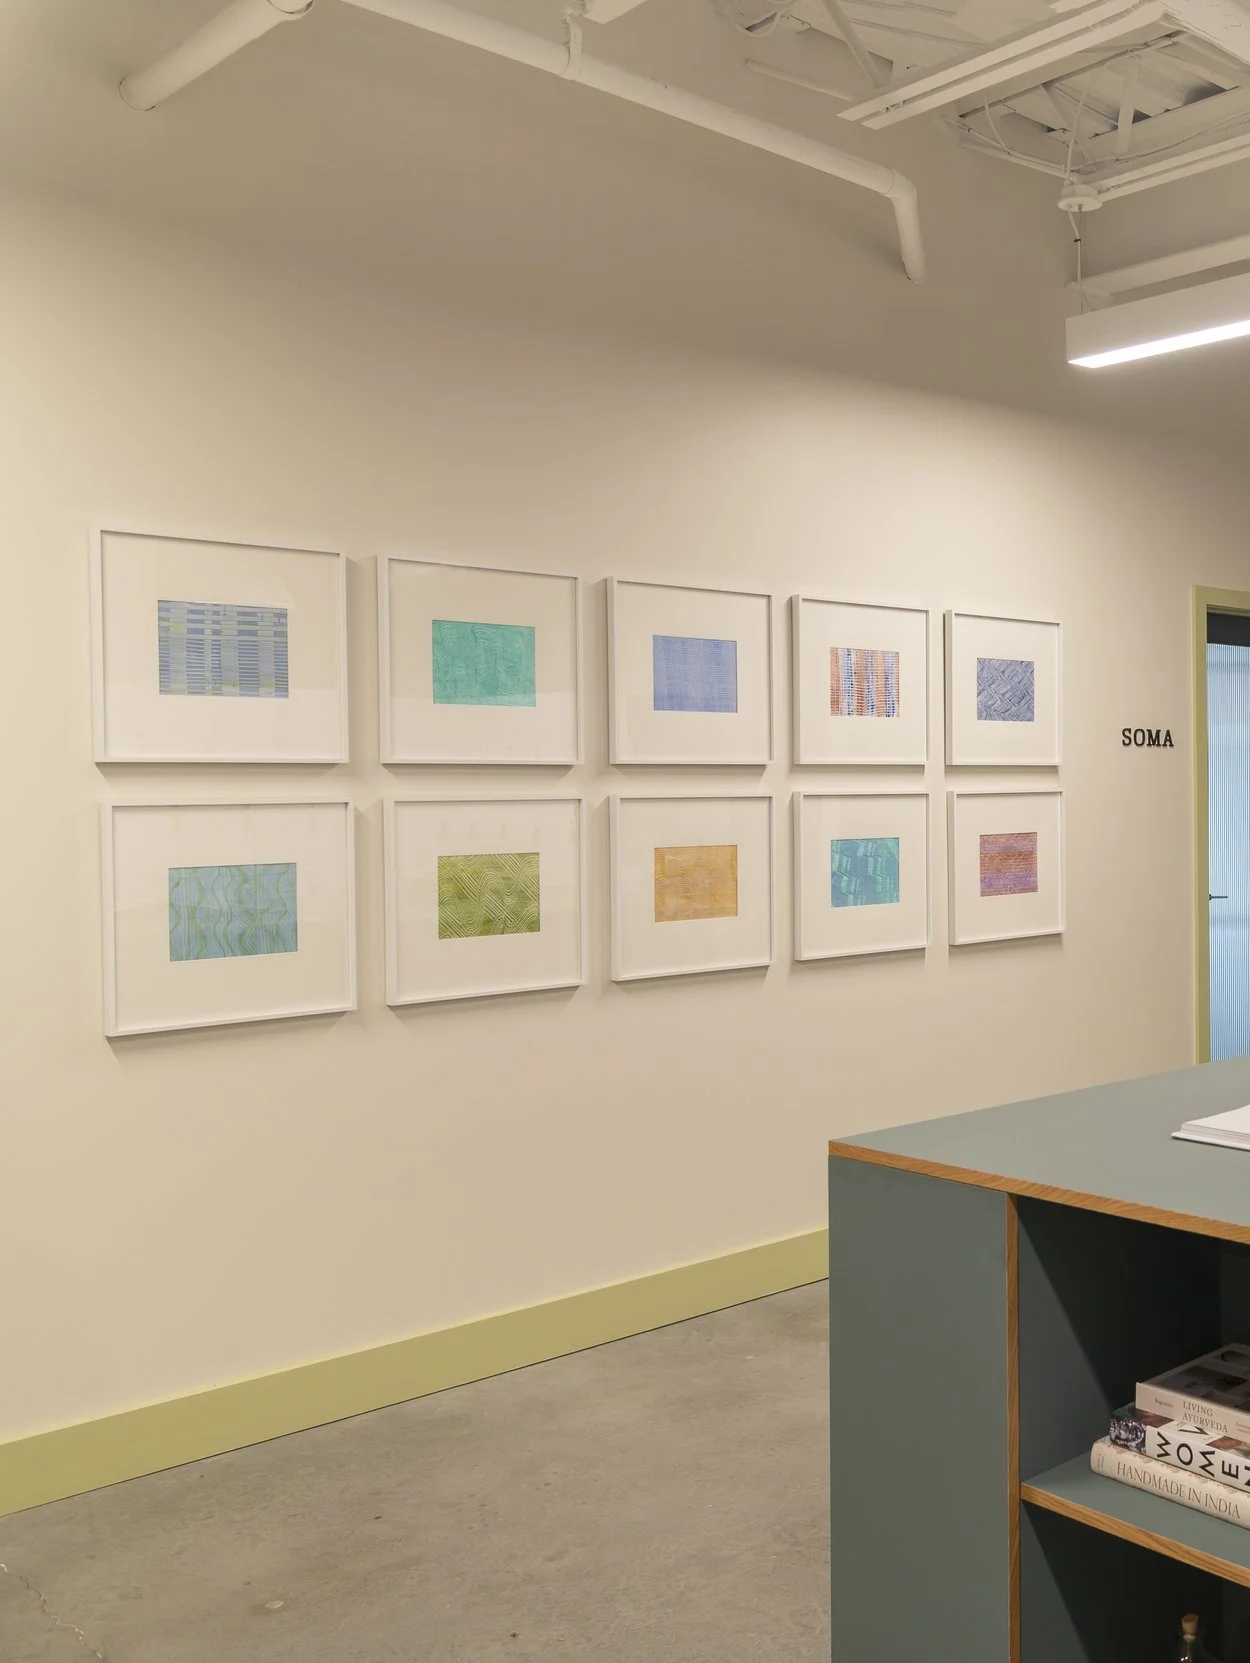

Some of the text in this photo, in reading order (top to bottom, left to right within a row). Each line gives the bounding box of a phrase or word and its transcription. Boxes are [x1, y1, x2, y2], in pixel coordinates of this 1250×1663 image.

[1122, 728, 1174, 747] SOMA
[1183, 1400, 1213, 1417] LIVING
[1182, 1412, 1229, 1434] AYURVEDA
[1116, 1461, 1241, 1519] HANDMADE IN INDIA
